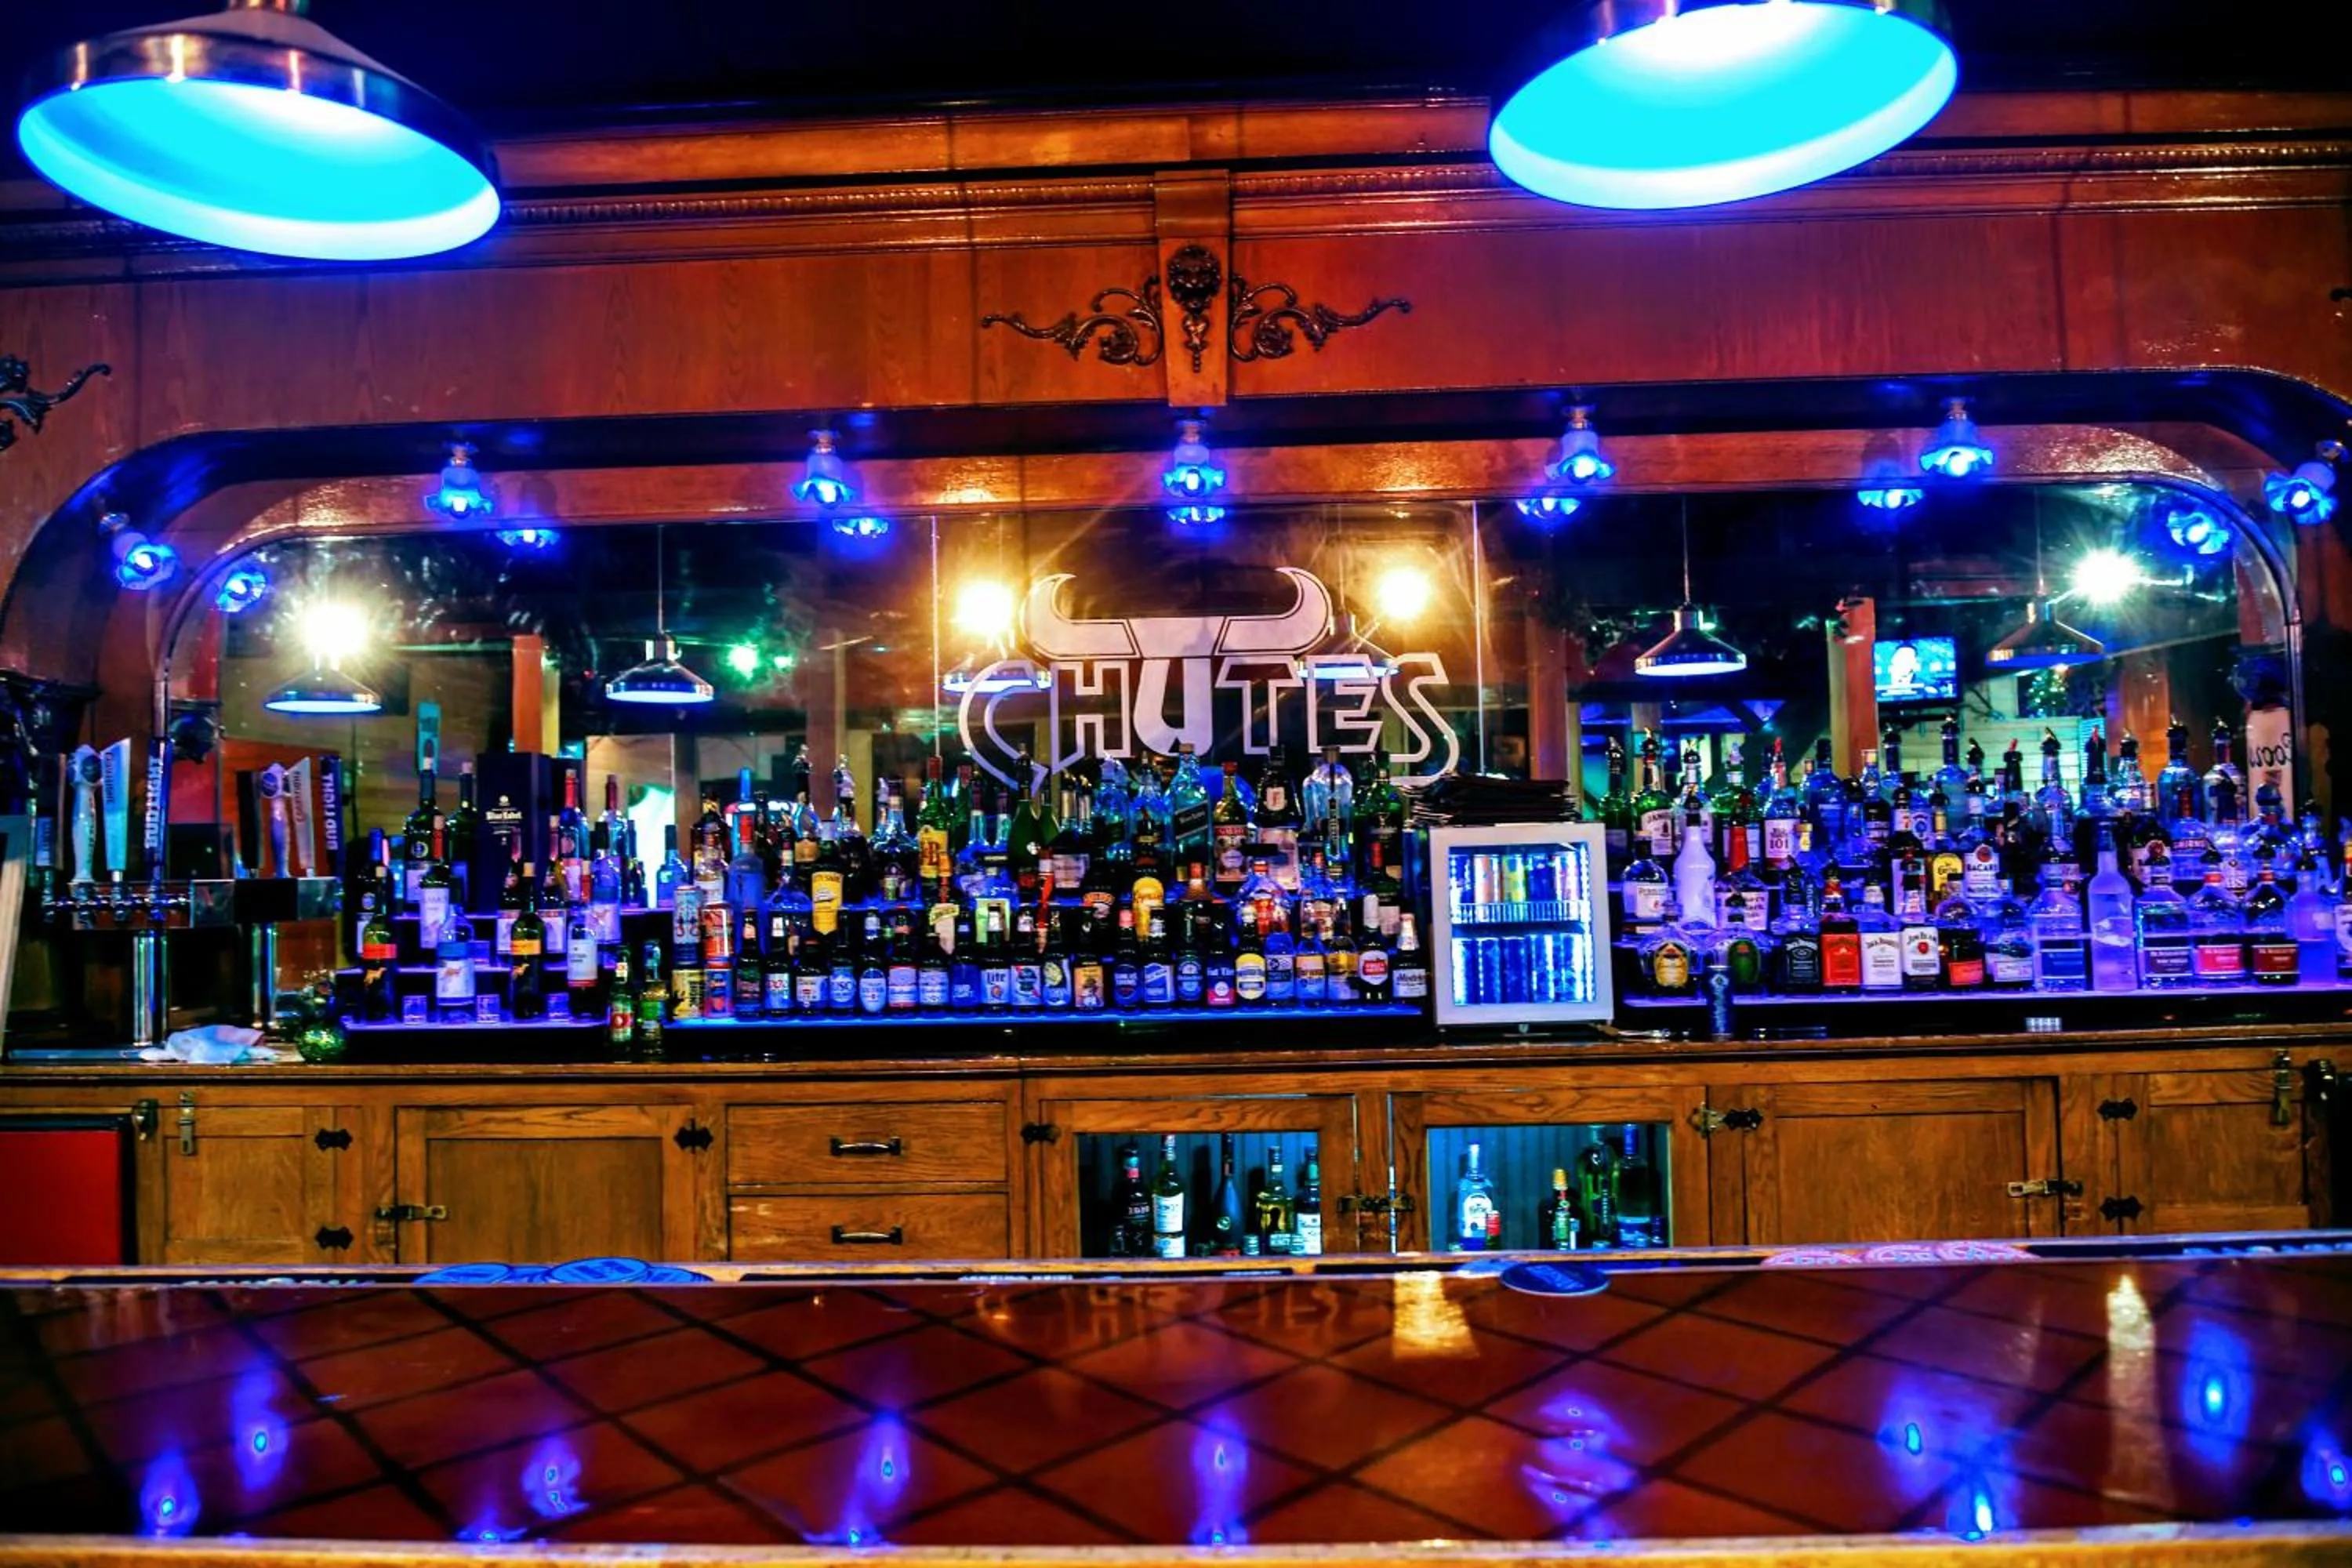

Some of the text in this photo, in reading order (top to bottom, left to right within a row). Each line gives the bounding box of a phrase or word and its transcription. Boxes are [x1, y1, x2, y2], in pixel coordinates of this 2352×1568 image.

[958, 652, 1461, 797] CHUTES
[1769, 838, 1789, 849] 101
[986, 972, 1006, 984] Lite
